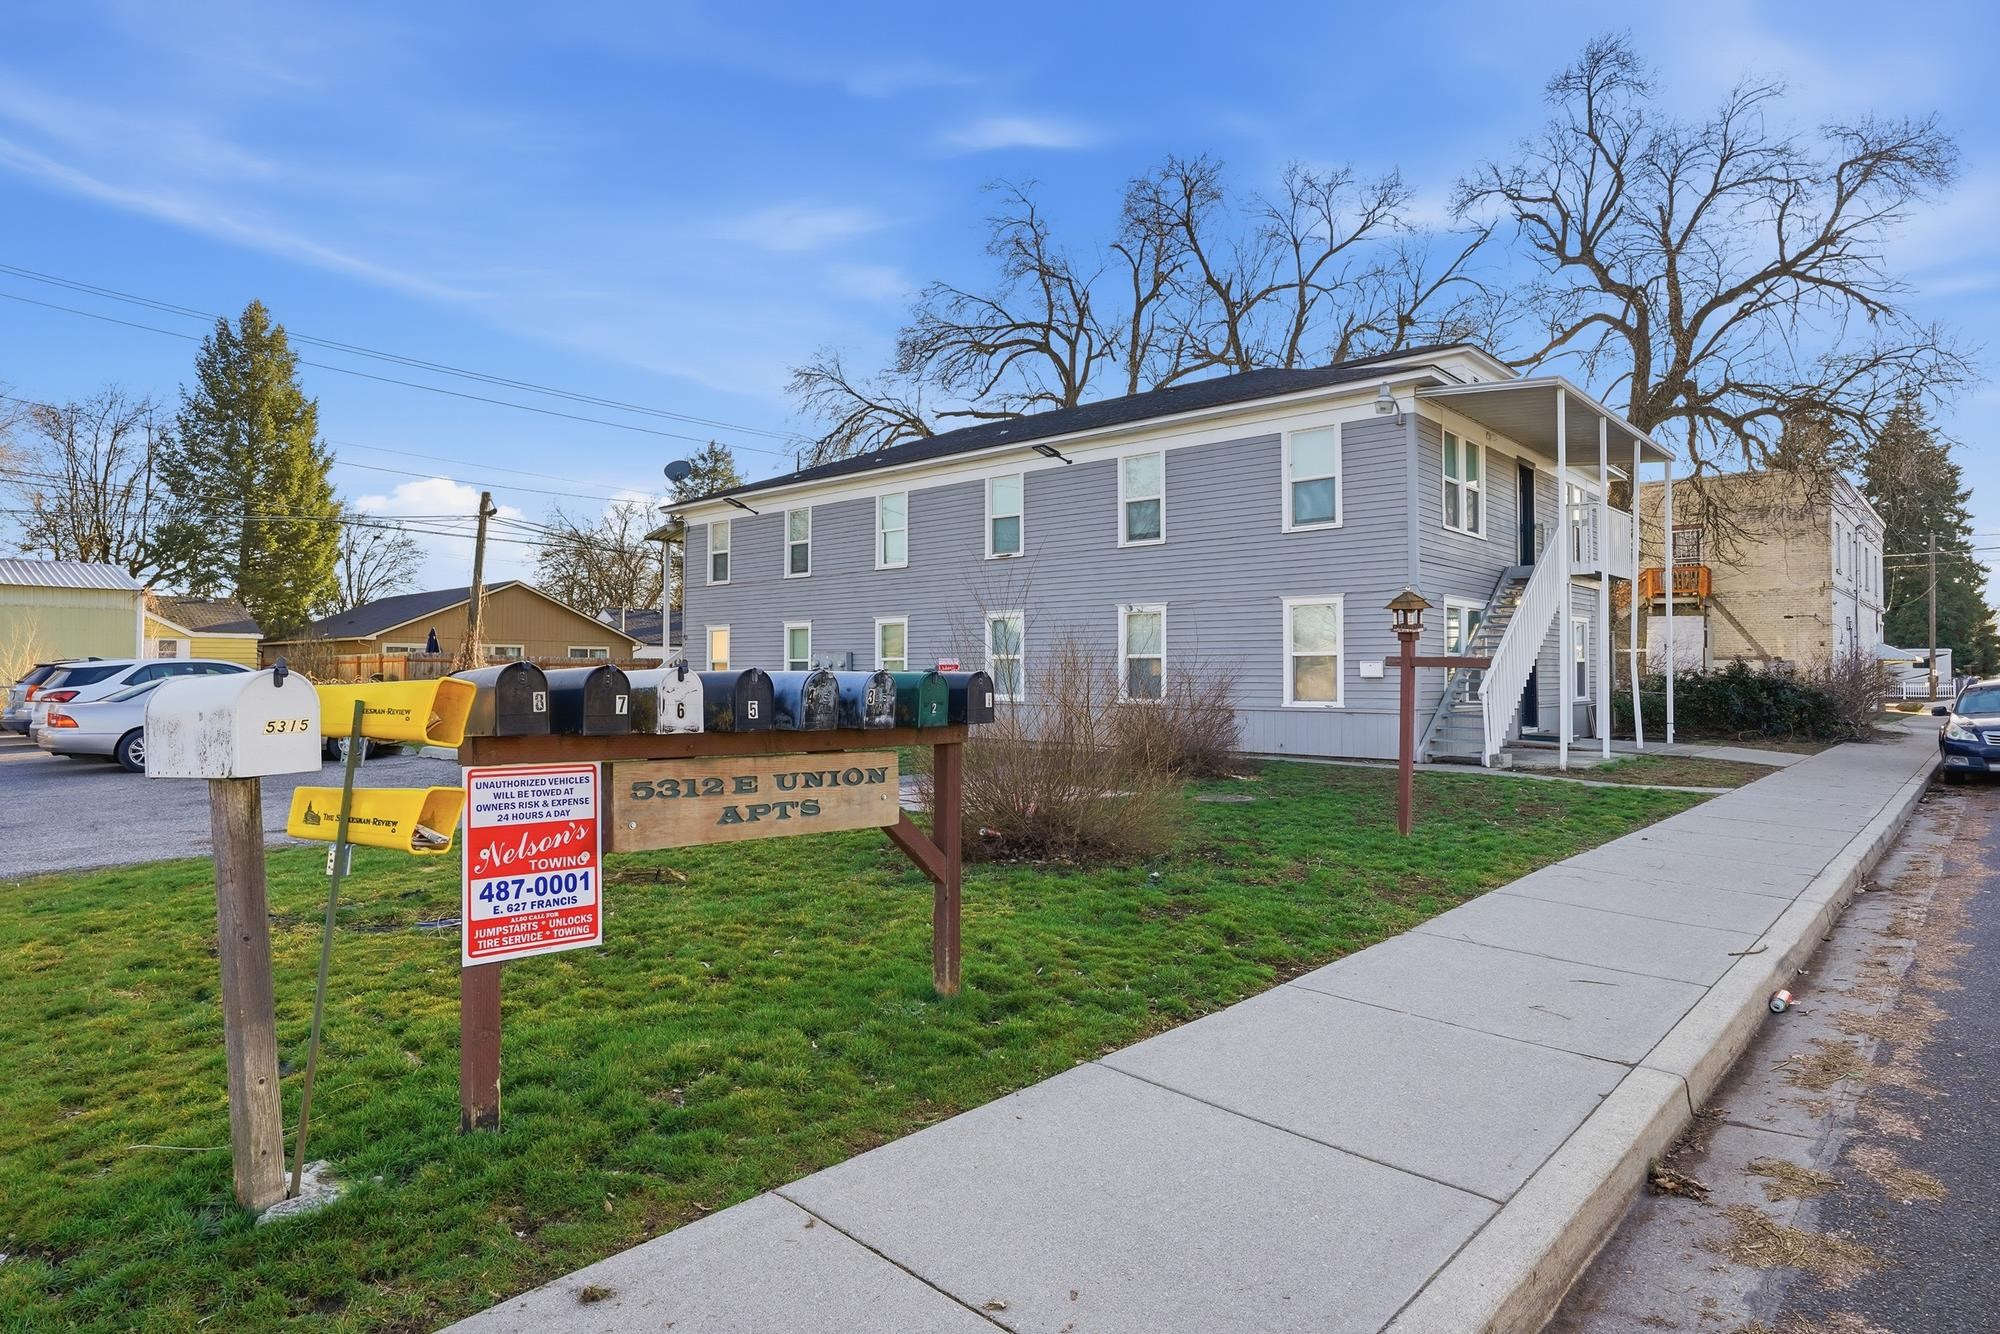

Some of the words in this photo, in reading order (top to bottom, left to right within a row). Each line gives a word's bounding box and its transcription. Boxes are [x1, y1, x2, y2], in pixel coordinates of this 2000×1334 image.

[534, 692, 546, 712] 8
[617, 696, 627, 713] 7
[867, 690, 875, 704] 3
[676, 702, 685, 719] 6
[749, 702, 757, 718] 5
[931, 703, 937, 714] 2
[265, 719, 309, 733] 5315
[475, 778, 547, 790] UNAUTHORIZED
[548, 776, 590, 785] VEHICLES
[630, 777, 725, 801] 5312
[731, 775, 759, 795] E
[772, 766, 889, 792] UNION
[493, 791, 516, 800] WILL
[517, 790, 529, 799] BE
[531, 788, 562, 798] TOWED
[563, 787, 575, 795] AT
[475, 802, 516, 812] OWNERS
[518, 800, 540, 809] RISK
[541, 799, 549, 808] &
[551, 797, 590, 807] EXPENSE
[716, 799, 821, 825] APT'S
[335, 814, 399, 827] SKESMAN-REVIEW
[497, 813, 509, 822] 24
[511, 811, 544, 821] HOURS
[545, 810, 552, 819] A
[554, 809, 571, 818] DAY
[474, 822, 589, 874] Nelson's
[529, 855, 588, 870] TOWING
[479, 871, 589, 902] 487-0001
[493, 905, 504, 915] E.
[506, 902, 527, 913] 627
[530, 895, 578, 910] FRANCIS
[473, 922, 539, 939] JUMPSTARTS
[549, 914, 593, 928] UNLOCKS
[477, 938, 500, 949] TIRE
[501, 931, 543, 945] SERVICE
[552, 925, 590, 938] TOWING
